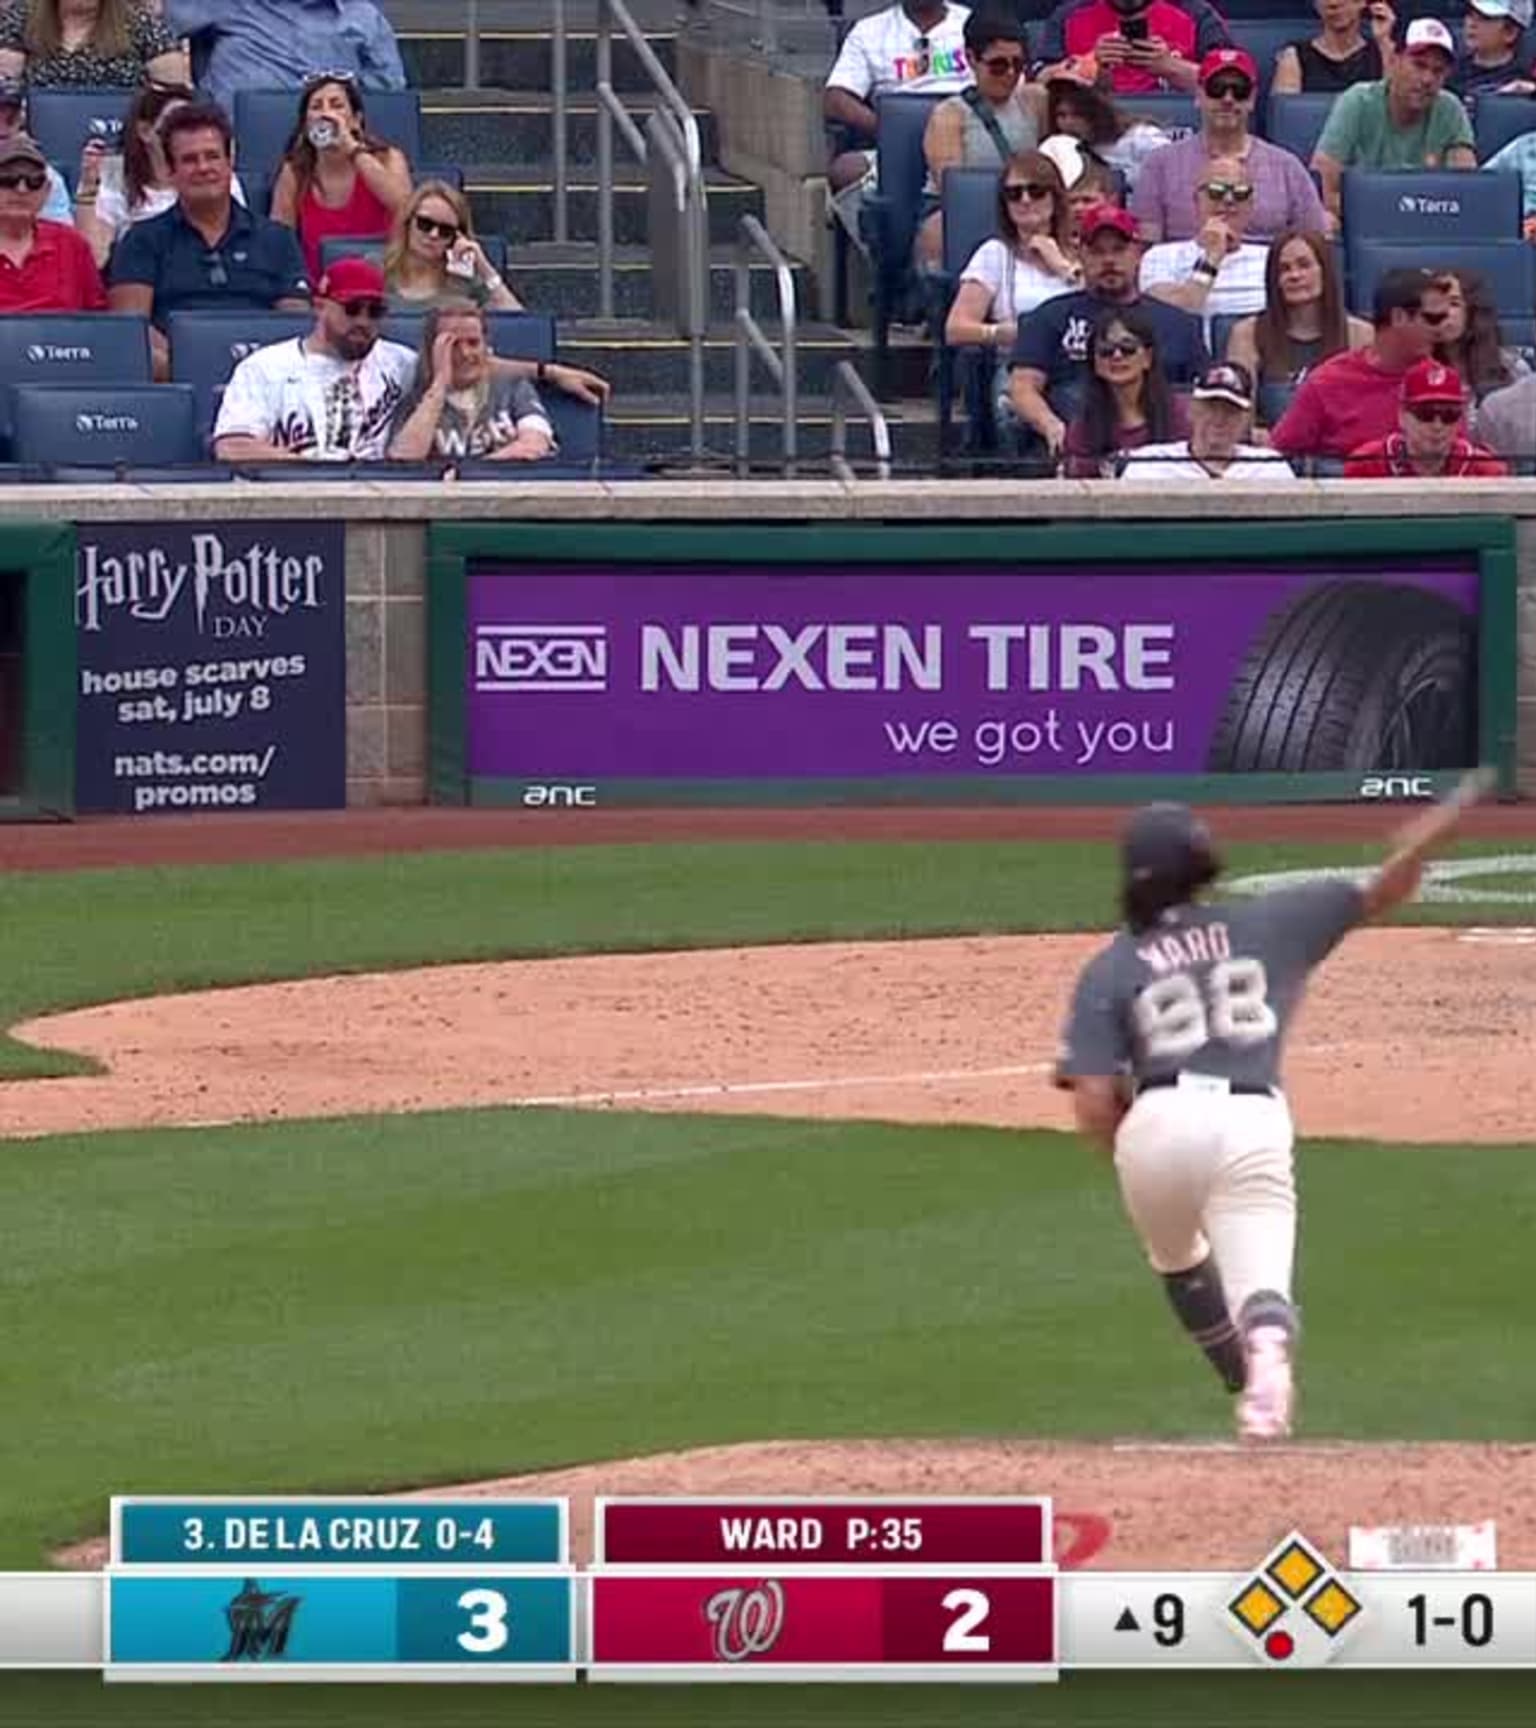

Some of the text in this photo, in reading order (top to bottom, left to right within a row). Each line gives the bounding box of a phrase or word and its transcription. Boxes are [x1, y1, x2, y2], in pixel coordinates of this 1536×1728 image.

[1417, 199, 1460, 213] Terra
[76, 533, 327, 634] Harry Potter
[214, 615, 268, 638] DAY
[82, 654, 306, 695] house scarves
[642, 624, 1175, 692] NEXEN TIRE
[118, 685, 271, 722] sat, july 8
[883, 709, 1174, 763] we got you
[114, 745, 276, 777] nats.com/
[135, 783, 256, 811] promos
[1131, 957, 1278, 1058] 98
